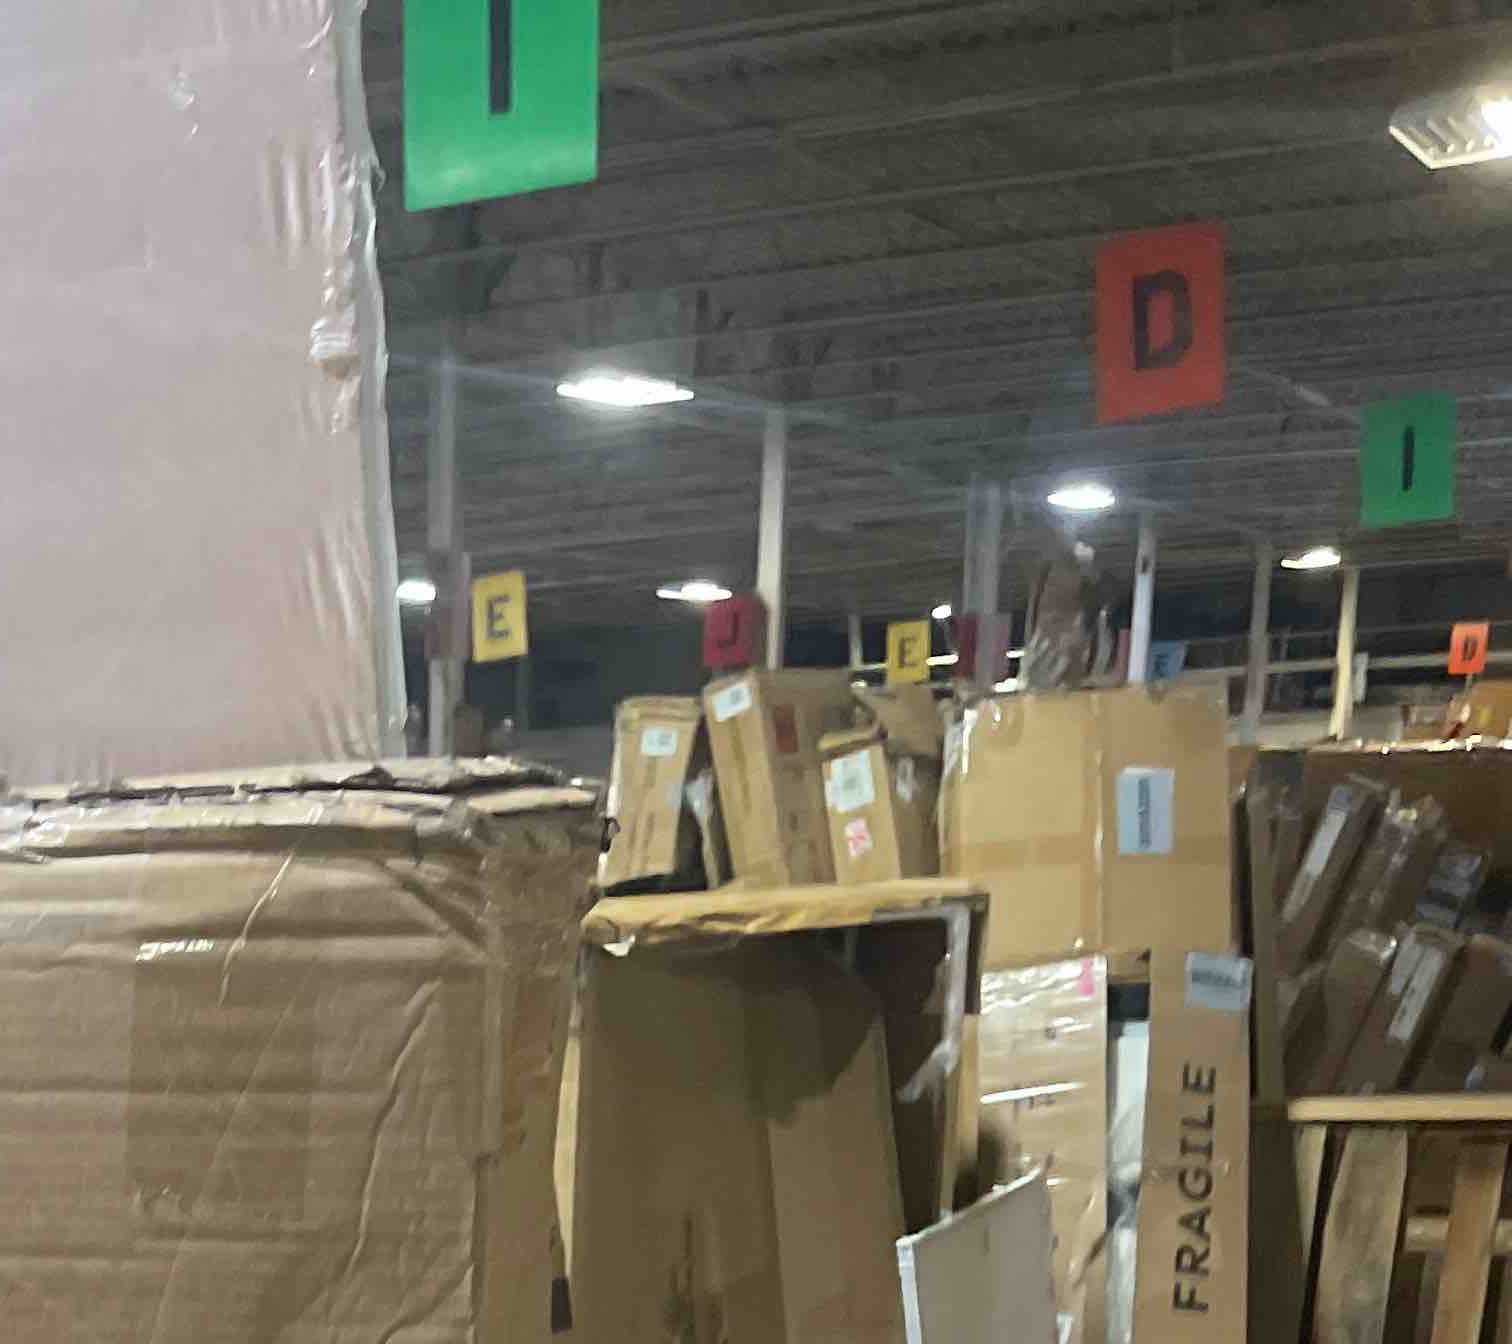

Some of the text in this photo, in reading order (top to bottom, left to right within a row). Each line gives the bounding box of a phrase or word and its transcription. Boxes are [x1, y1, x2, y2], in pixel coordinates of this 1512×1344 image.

[1132, 270, 1192, 371] D
[1402, 427, 1415, 492] I
[487, 597, 511, 640] E
[898, 637, 916, 668] E
[1173, 1058, 1217, 1318] FRAGILE
